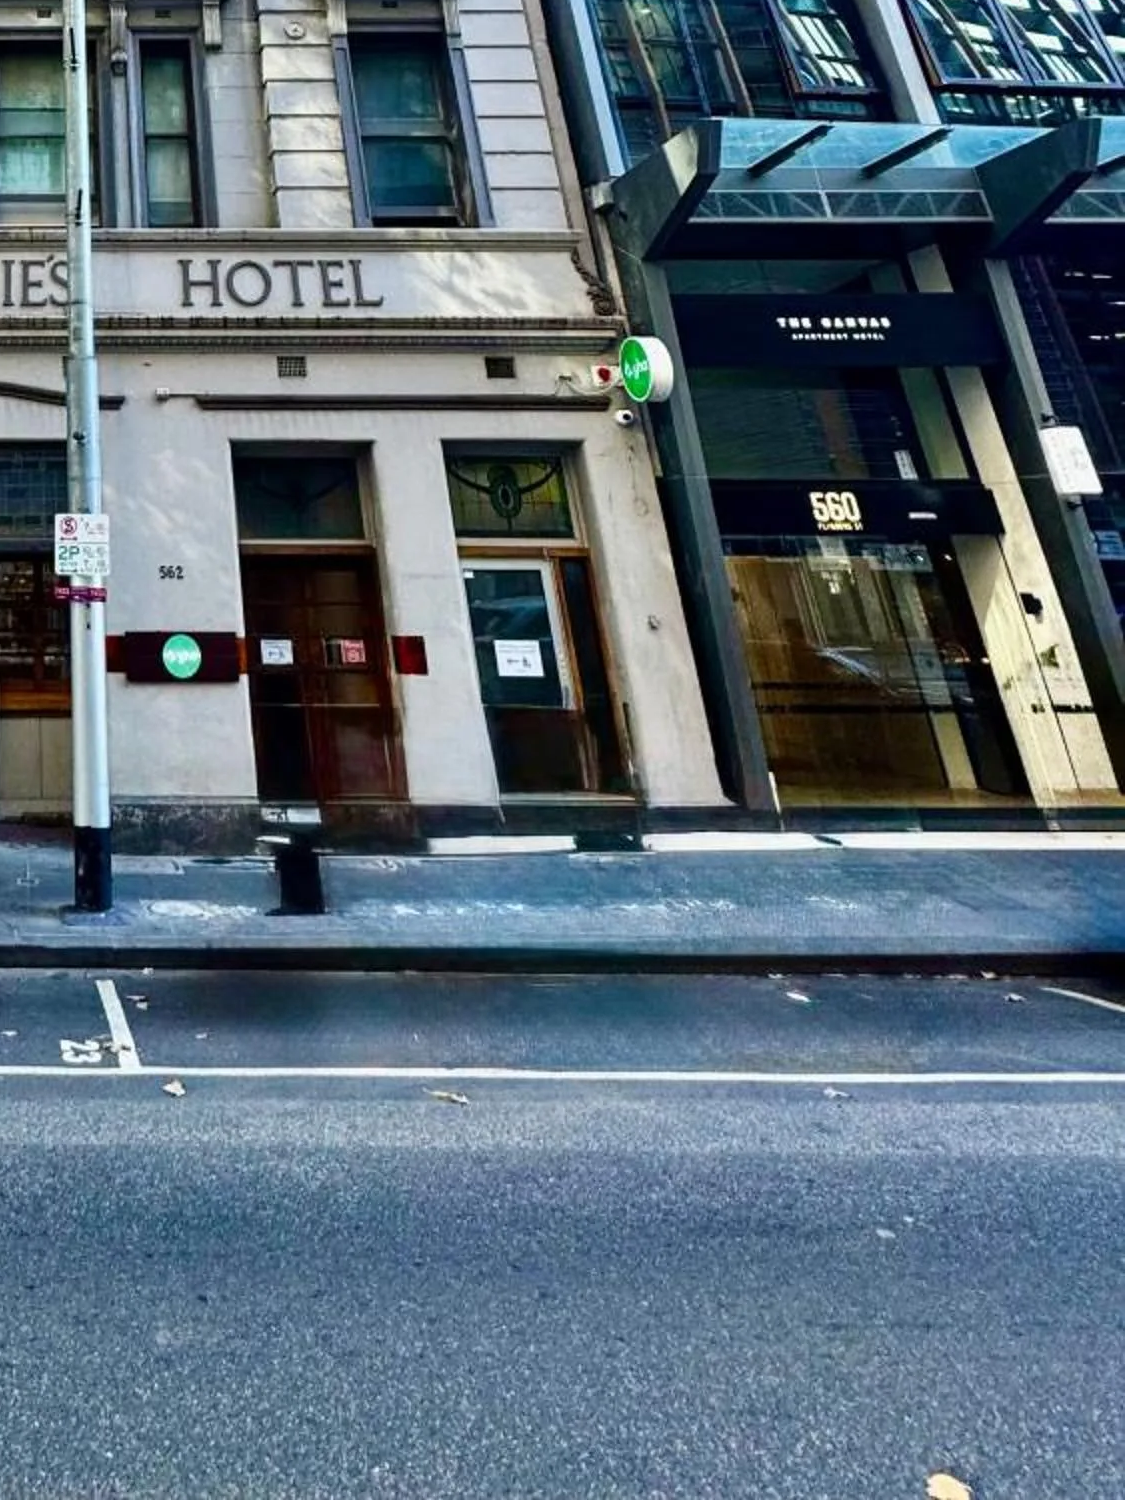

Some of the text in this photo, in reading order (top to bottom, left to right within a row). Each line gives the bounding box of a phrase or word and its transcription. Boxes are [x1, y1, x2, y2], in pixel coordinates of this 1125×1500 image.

[177, 258, 385, 308] HOTEL
[776, 317, 812, 329] THE
[809, 491, 862, 522] 560
[58, 545, 80, 561] 2P
[158, 565, 185, 580] 562
[59, 1039, 102, 1063] 23
